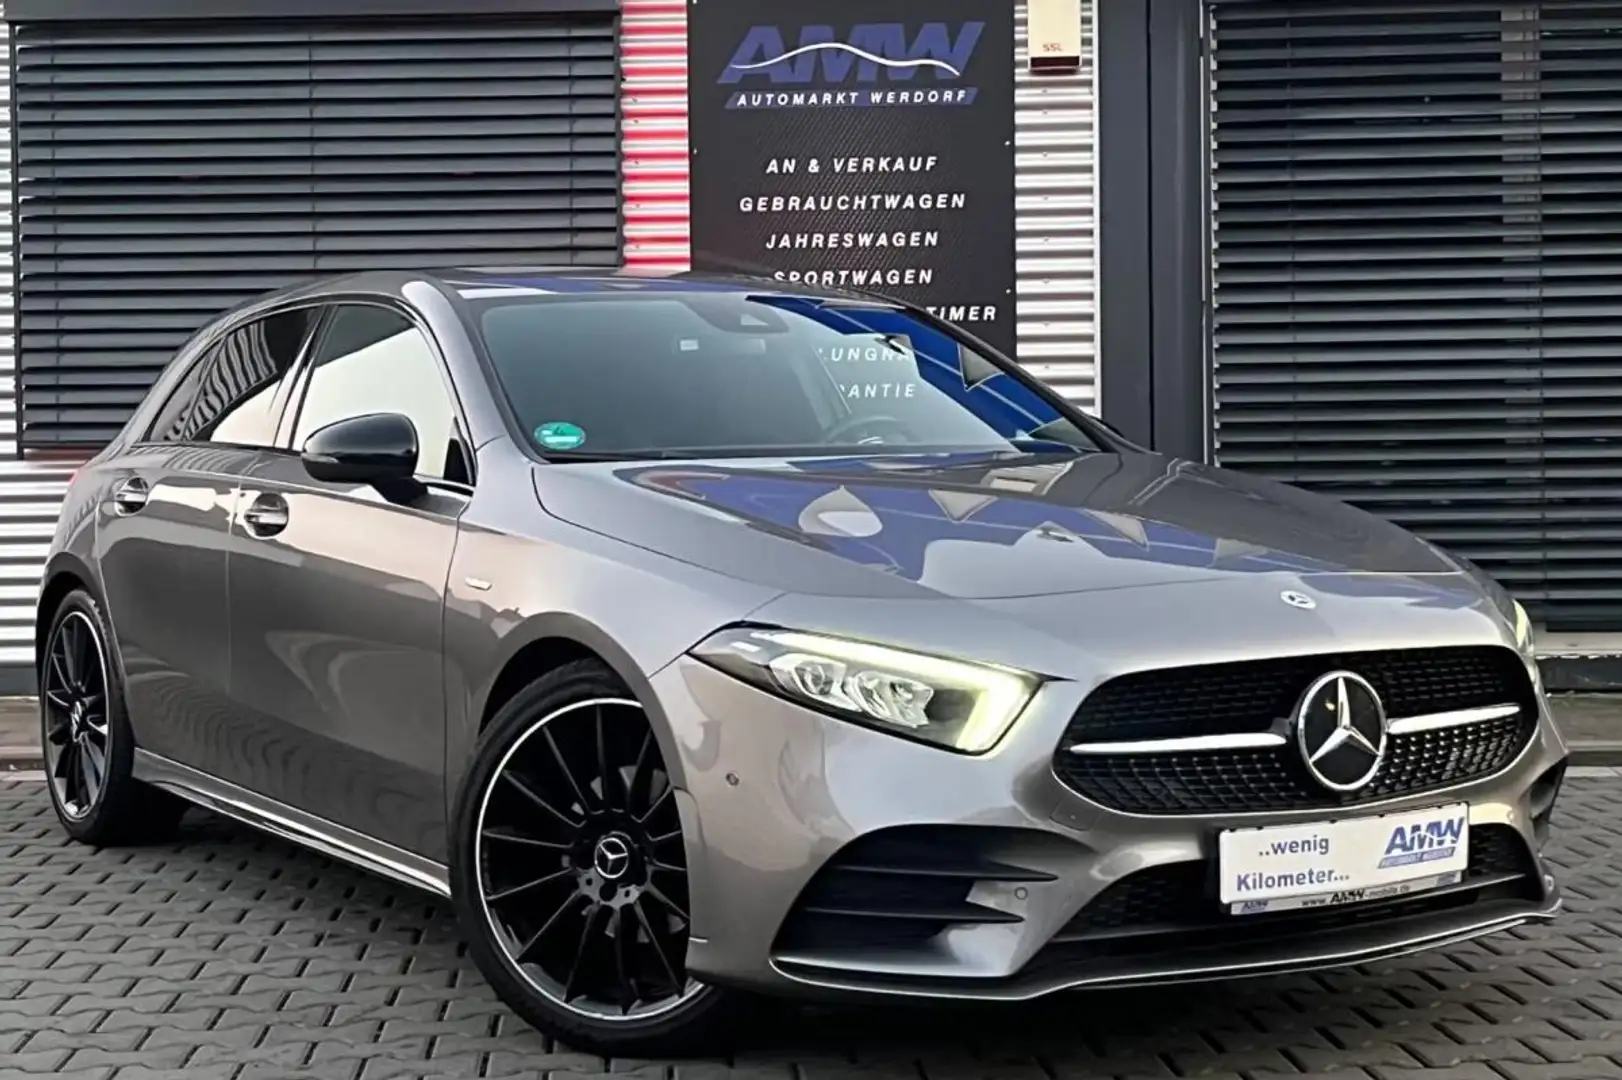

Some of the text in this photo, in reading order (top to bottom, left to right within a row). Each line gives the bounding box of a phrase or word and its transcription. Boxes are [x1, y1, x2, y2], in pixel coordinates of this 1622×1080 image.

[717, 21, 986, 85] AMW
[737, 90, 967, 107] AUTOMARKT WERDORF
[766, 156, 938, 174] AN & VERKAUF
[739, 194, 966, 212] GEBRAUCHTWAGEN
[765, 231, 939, 249] JAHRESWAGEN
[774, 268, 933, 286] SPORTWAGEN
[839, 383, 917, 398] ANTIE
[1384, 816, 1465, 855] AMW
